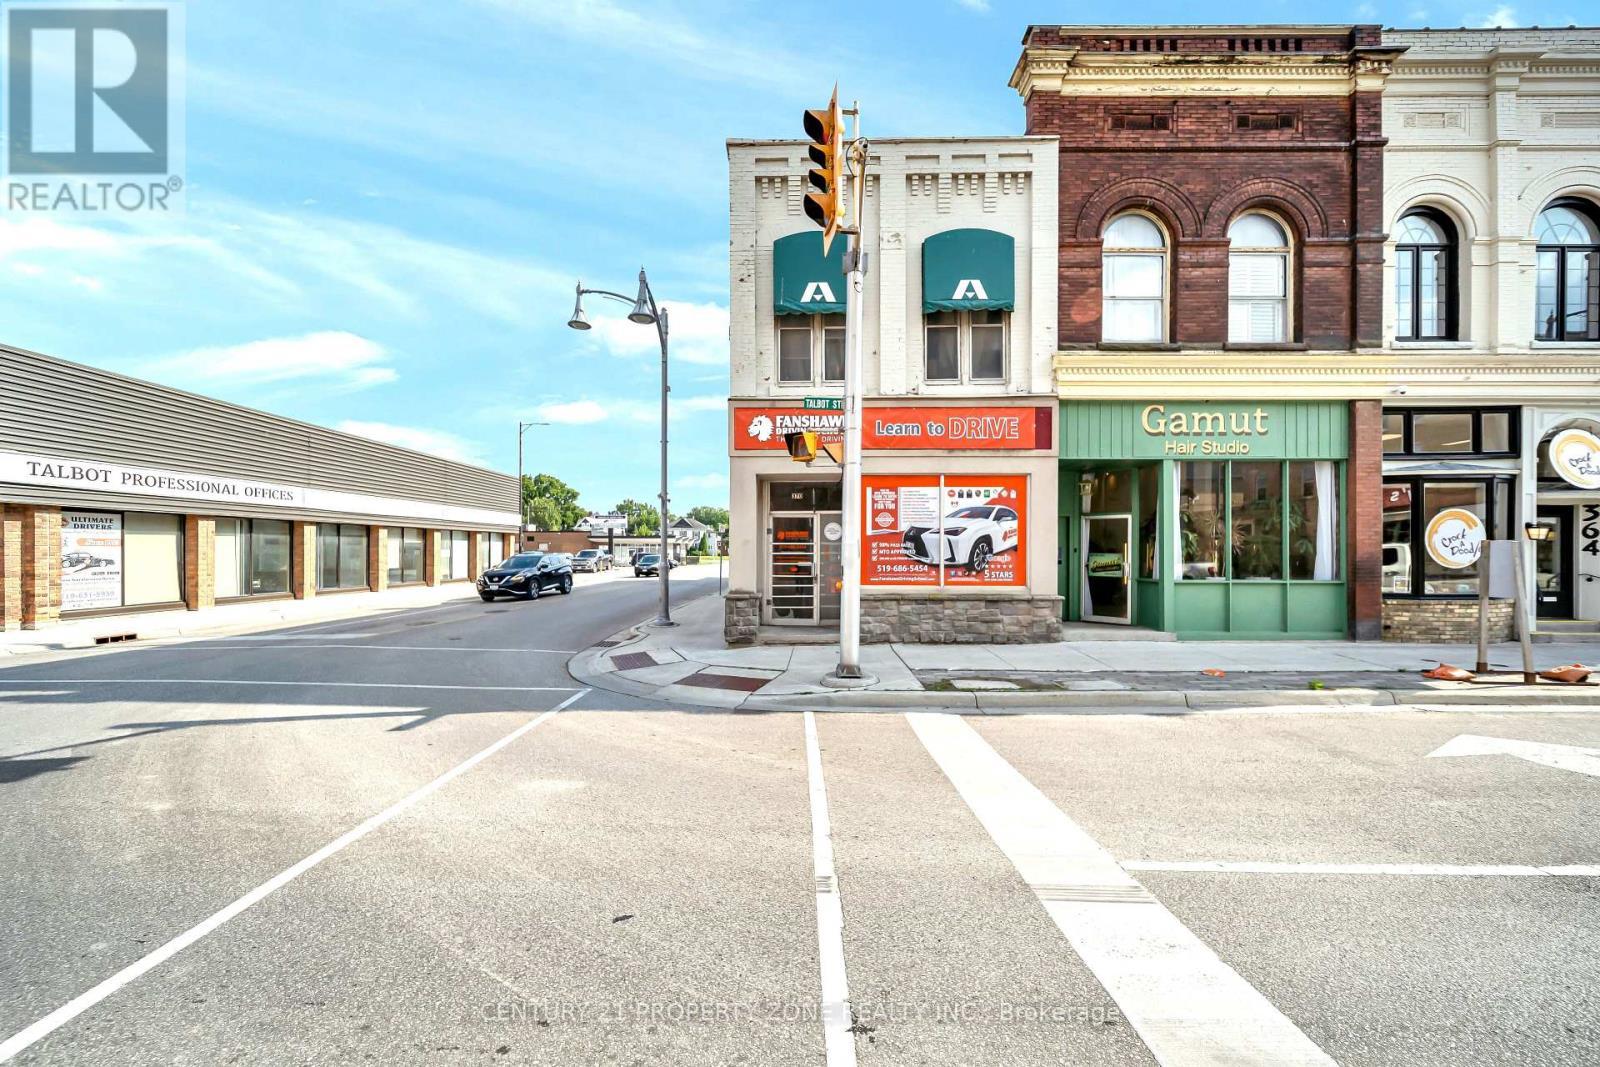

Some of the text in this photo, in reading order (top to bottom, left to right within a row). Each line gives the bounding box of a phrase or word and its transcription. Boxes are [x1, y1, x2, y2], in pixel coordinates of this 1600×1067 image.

[805, 399, 830, 409] TALBOT
[875, 416, 1020, 439] Learn to DRIVE
[1142, 405, 1268, 435] Gamut
[821, 435, 845, 443] DRIVIN
[1165, 440, 1250, 455] Hair Studio
[26, 460, 295, 502] TALBOT PROFESSIONAL OFFICES
[71, 516, 115, 524] ULTIMATE
[1440, 528, 1467, 549] Crock
[1450, 541, 1480, 558] Doodl
[984, 569, 991, 578] 5
